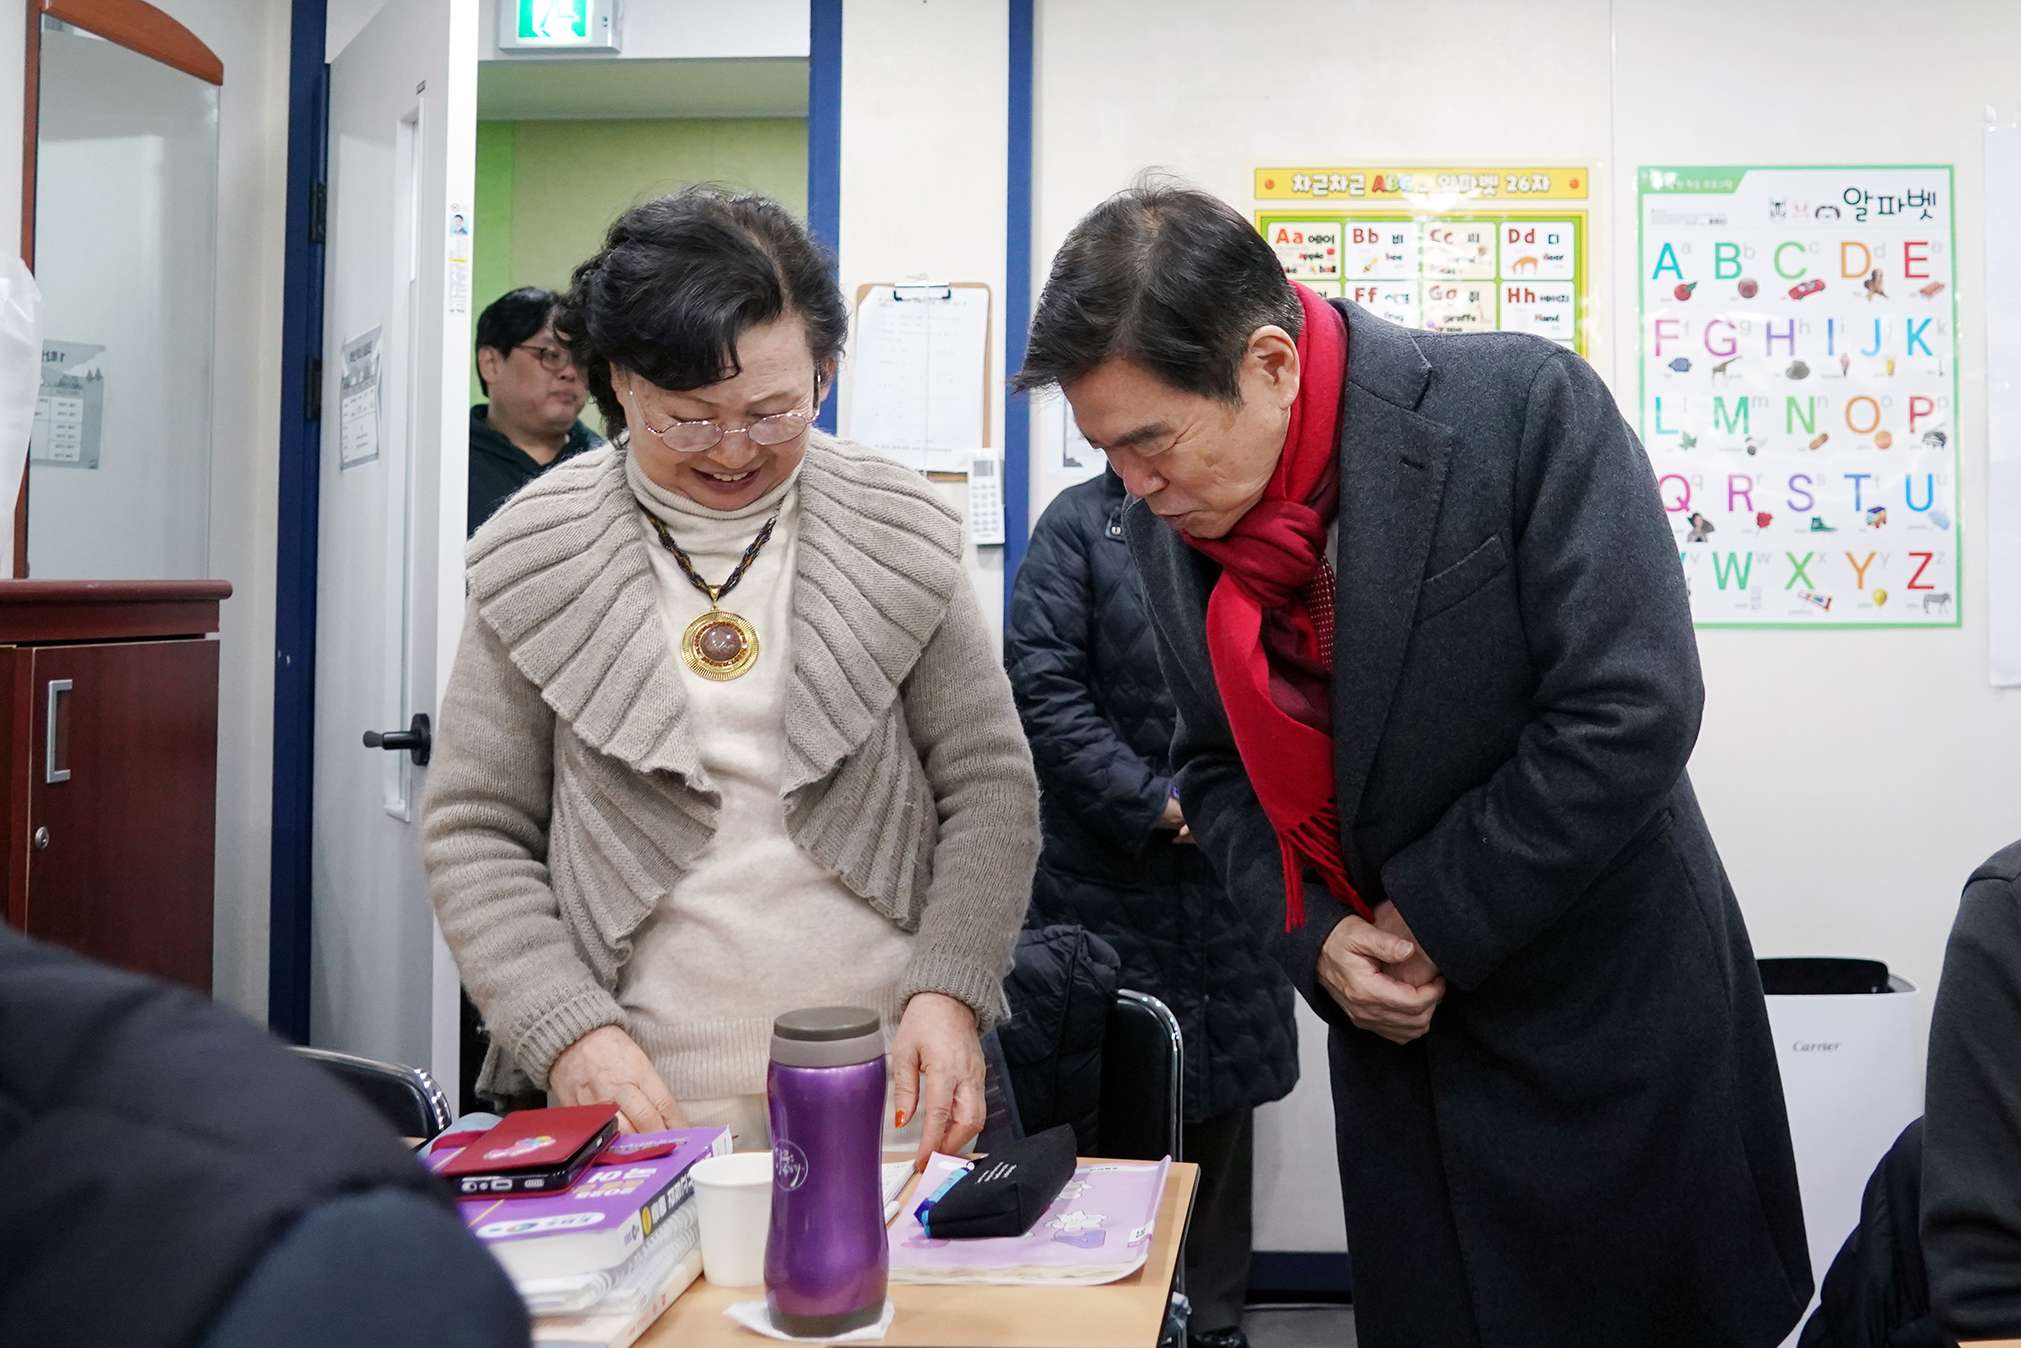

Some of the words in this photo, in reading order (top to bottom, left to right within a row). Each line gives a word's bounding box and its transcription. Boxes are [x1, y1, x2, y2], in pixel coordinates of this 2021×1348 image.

[1292, 173, 1366, 196] 차근차근
[1505, 174, 1551, 193] 26자
[1843, 187, 1936, 222] 알파벳
[1308, 235, 1335, 244] 에이
[1392, 234, 1404, 245] 비
[1548, 233, 1560, 244] 디
[1652, 242, 1684, 279] A
[1715, 242, 1742, 279] B
[1774, 241, 1807, 279] C
[1841, 242, 1871, 278] D
[1904, 242, 1929, 278] E
[1656, 319, 1679, 356] F
[1704, 319, 1736, 356] G
[1766, 318, 1795, 356] H
[1828, 318, 1834, 356] I
[1860, 318, 1881, 356] J
[1907, 318, 1933, 356] K
[1655, 396, 1679, 434] L
[1714, 396, 1748, 434] M
[1787, 396, 1815, 434] N
[1845, 396, 1880, 434] O
[1909, 396, 1935, 434] P
[1659, 474, 1691, 512] Q
[1728, 474, 1753, 512] R
[1787, 474, 1814, 512] S
[1844, 474, 1871, 511] T
[1905, 473, 1933, 512] U
[1712, 552, 1752, 590] W
[1785, 552, 1815, 590] X
[1846, 552, 1876, 590] Y
[1908, 552, 1935, 590] Z
[1792, 1040, 1842, 1052] Carrier
